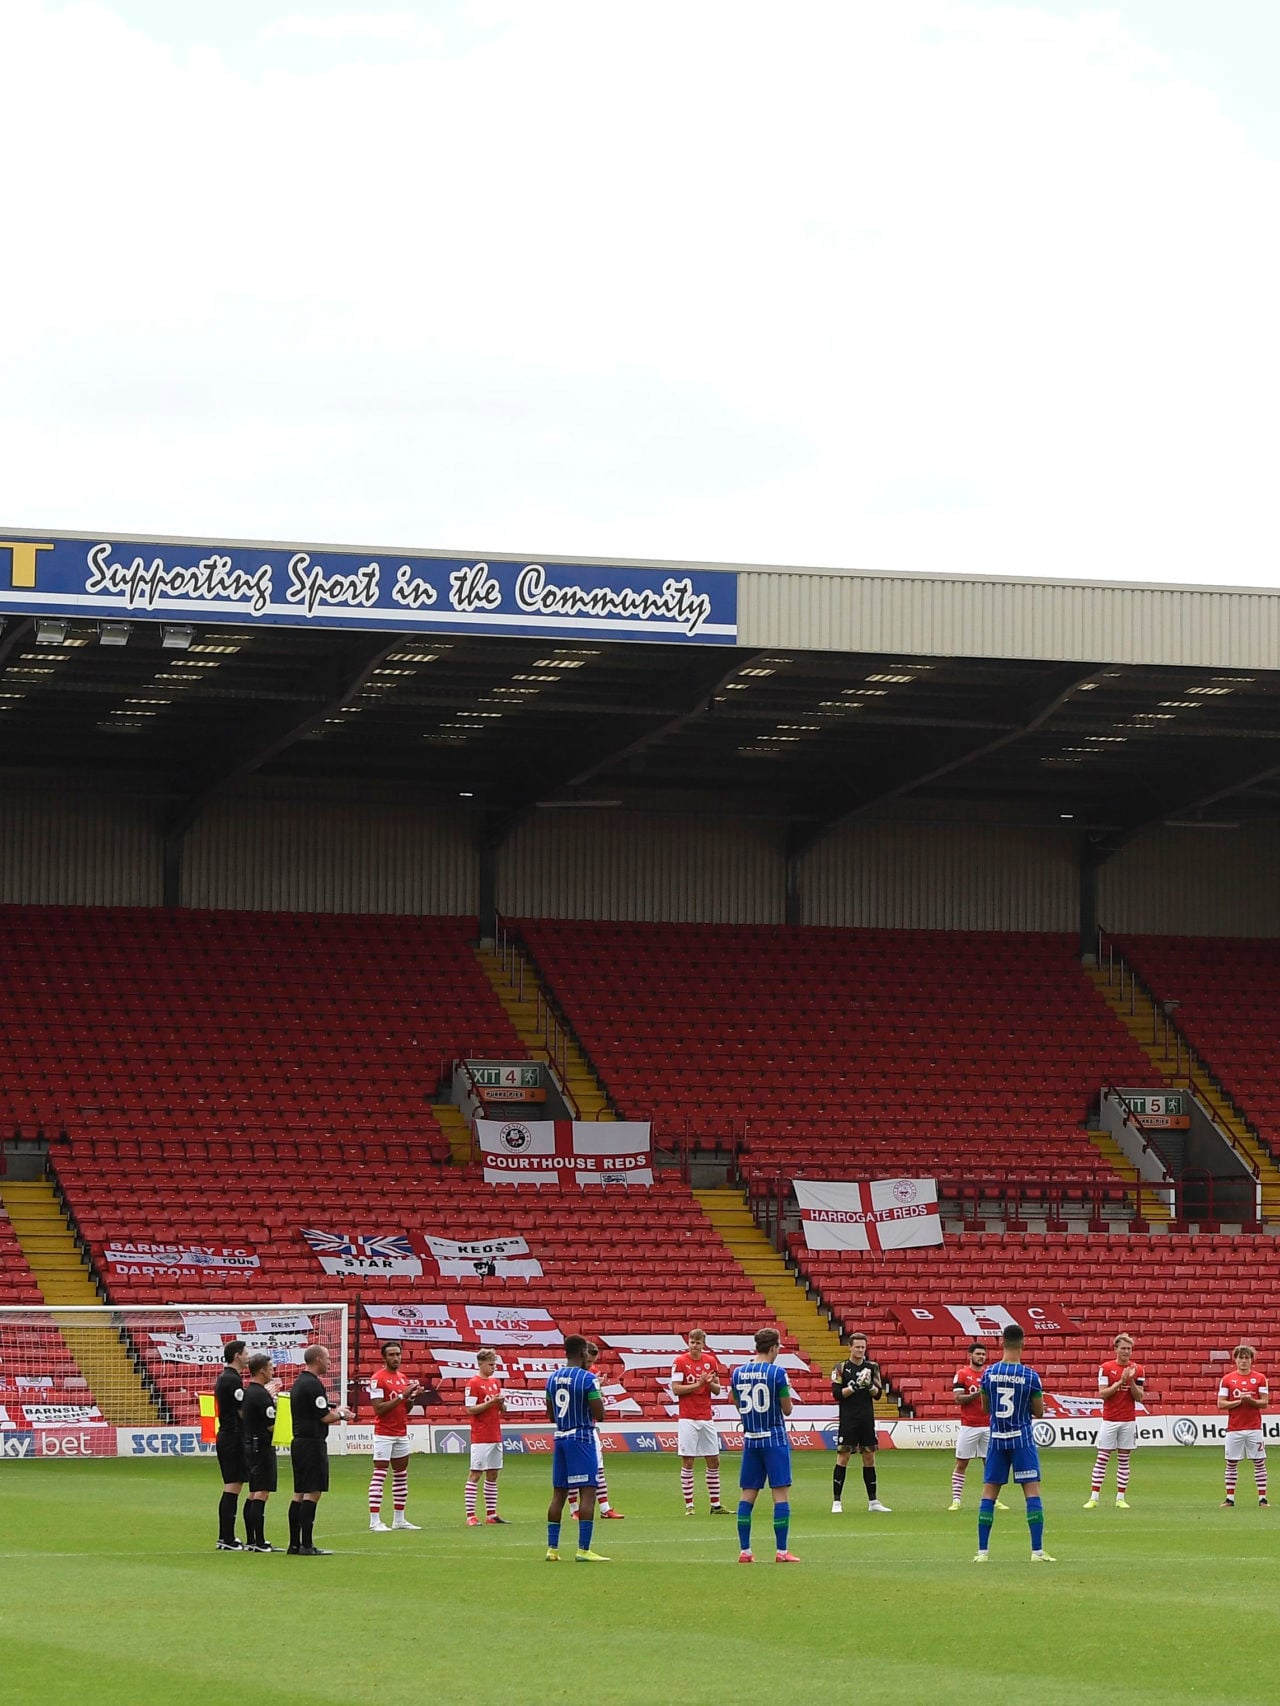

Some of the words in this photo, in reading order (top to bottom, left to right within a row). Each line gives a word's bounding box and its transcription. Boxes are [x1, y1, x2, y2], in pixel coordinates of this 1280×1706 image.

[89, 546, 271, 612] Supporting
[288, 556, 377, 614] Sport
[396, 567, 434, 603] in
[453, 565, 499, 608] the
[518, 566, 708, 633] Community
[505, 1070, 517, 1084] 4
[1150, 1099, 1161, 1112] 5
[486, 1154, 596, 1170] COURTHOUSE
[603, 1154, 647, 1170] REDS
[810, 1210, 891, 1223] HARROGATE
[894, 1205, 928, 1219] REDS
[109, 1242, 216, 1255] BARNSLEY
[221, 1248, 247, 1257] FC
[344, 1259, 393, 1268] STAR
[911, 1308, 934, 1320] B
[1027, 1307, 1046, 1319] C
[398, 1318, 458, 1328] SELBY
[468, 1319, 530, 1331] TYKES
[1034, 1322, 1061, 1330] REDS
[555, 1388, 571, 1418] 9
[736, 1383, 770, 1414] 30
[995, 1387, 1015, 1418] 3
[25, 1406, 93, 1416] BARNSLEY
[36, 1412, 89, 1420] LEGEND
[909, 1425, 926, 1433] THE
[929, 1424, 951, 1433] UK'S
[42, 1432, 92, 1455] bet
[504, 1438, 524, 1452] sky
[526, 1435, 551, 1450] bet
[636, 1435, 657, 1450] sky
[789, 1434, 814, 1447] bet
